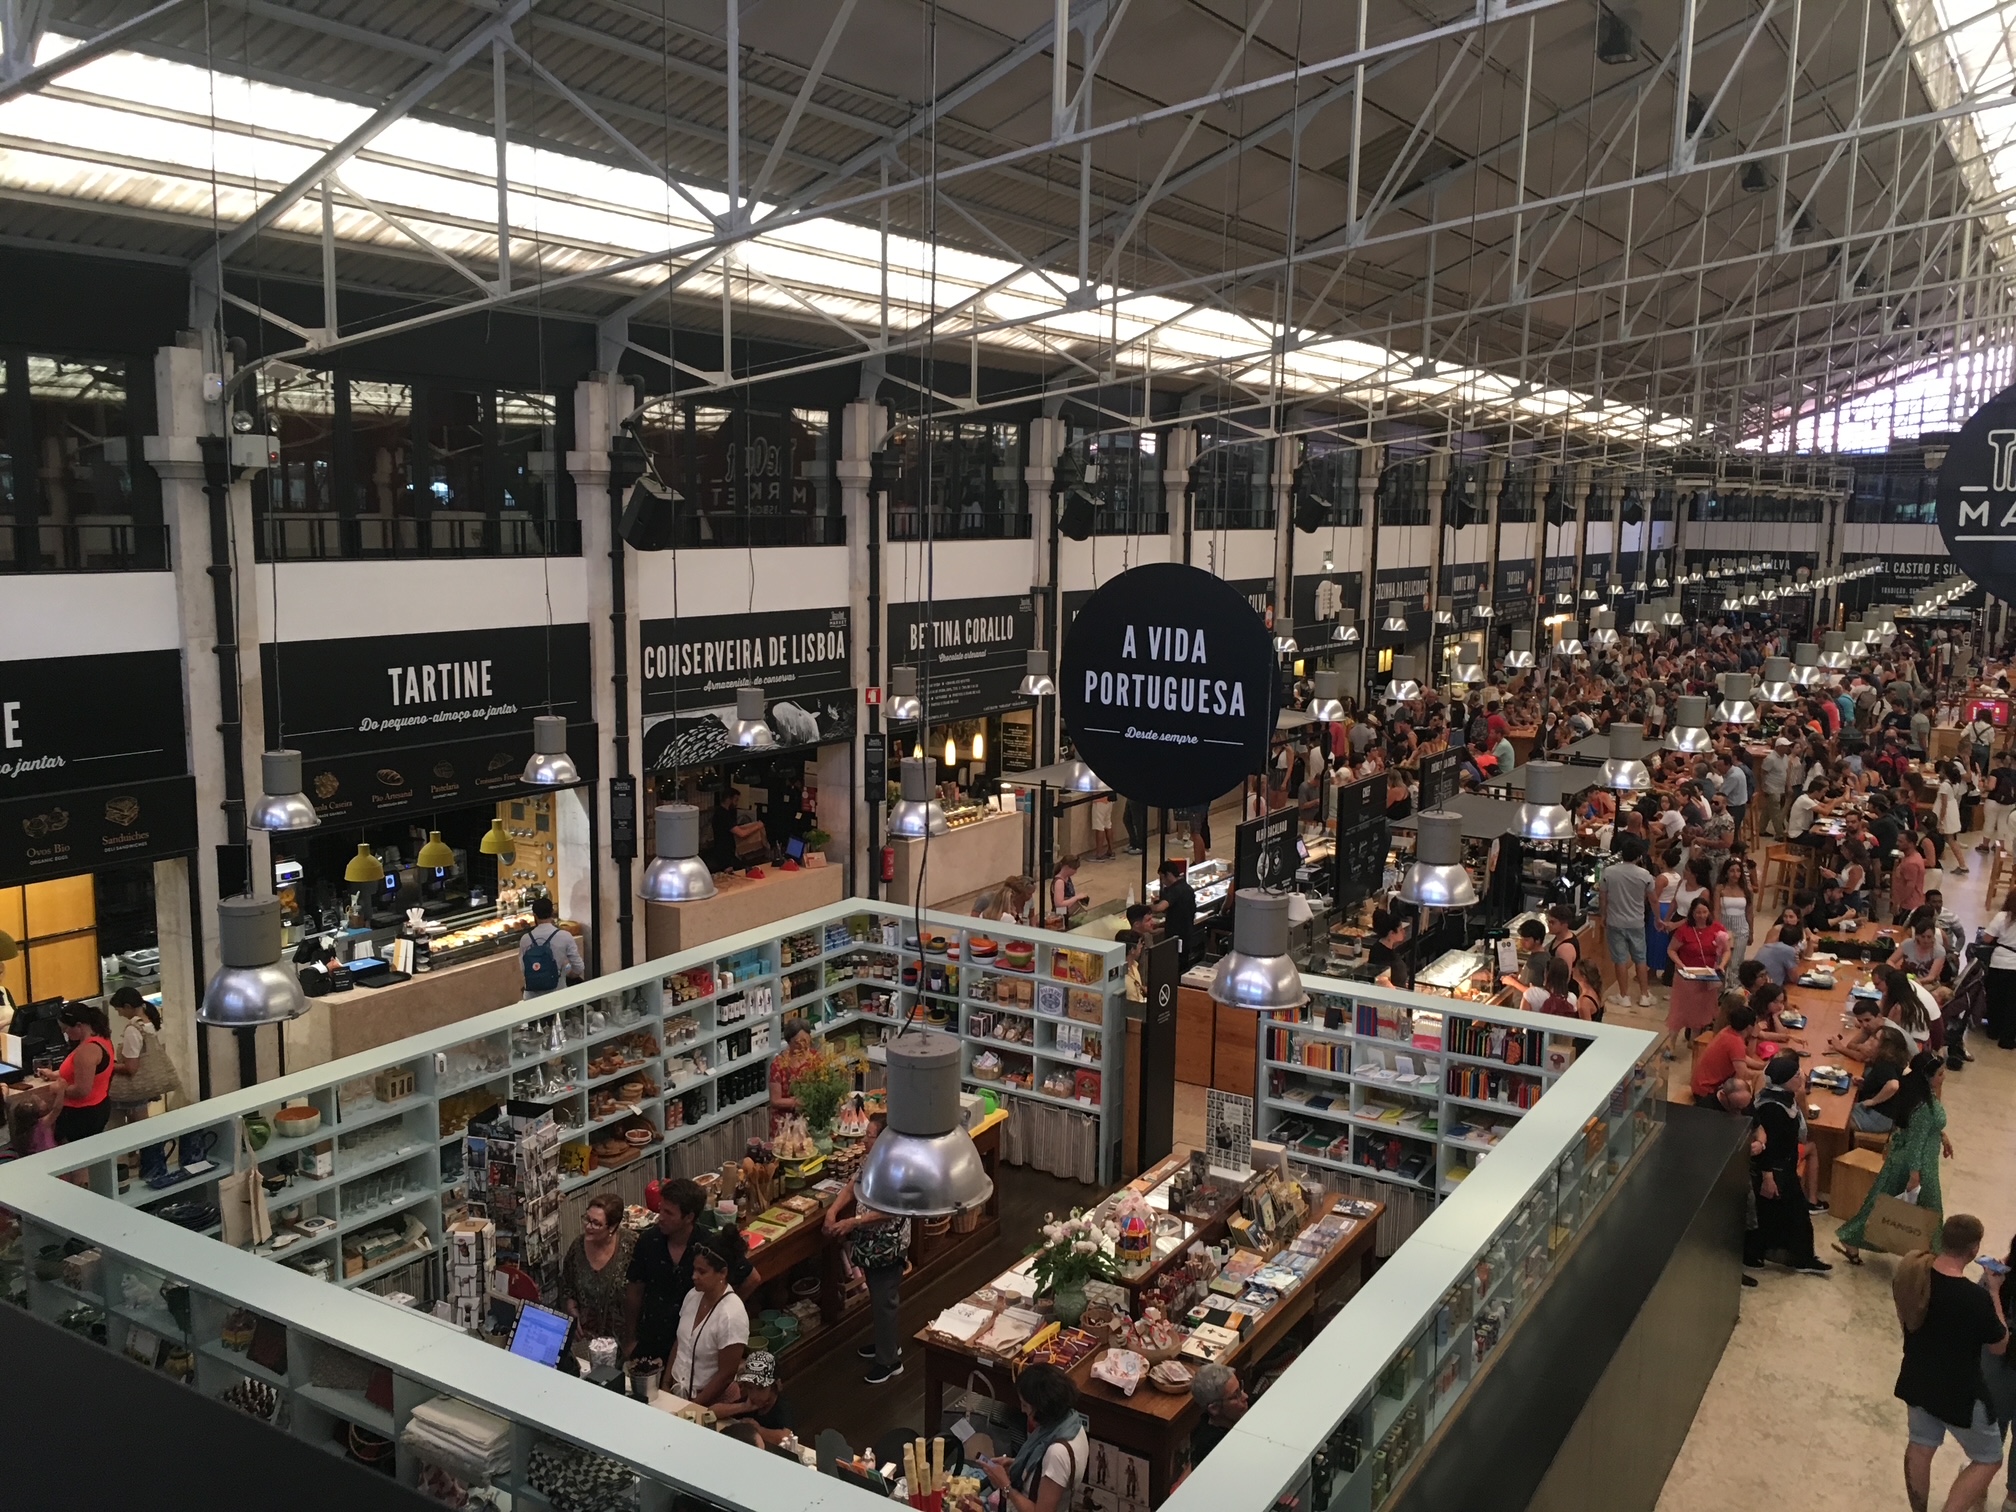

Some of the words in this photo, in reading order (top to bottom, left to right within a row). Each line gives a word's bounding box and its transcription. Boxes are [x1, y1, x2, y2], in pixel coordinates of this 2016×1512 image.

[1893, 562, 1930, 574] CASTRO
[1934, 563, 1940, 575] E
[965, 614, 1014, 645] CORALLO
[1121, 624, 1137, 659] A
[1147, 625, 1207, 664] VIDA
[643, 637, 764, 680] CONSERVEIRA
[769, 635, 788, 668] DE
[792, 630, 846, 665] LISBOA
[387, 660, 493, 706] TARTINE
[1084, 670, 1246, 717] PORTUGUESA
[359, 717, 380, 733] Do
[379, 710, 471, 732] pequeno-almoço
[472, 708, 486, 719] ao
[484, 703, 518, 721] jantar
[1124, 726, 1159, 741] Desde
[1159, 733, 1199, 745] sempre
[10, 755, 66, 778] jantar
[26, 846, 52, 858] Ovos
[53, 843, 70, 855] Bio
[102, 831, 149, 846] Sanduiches
